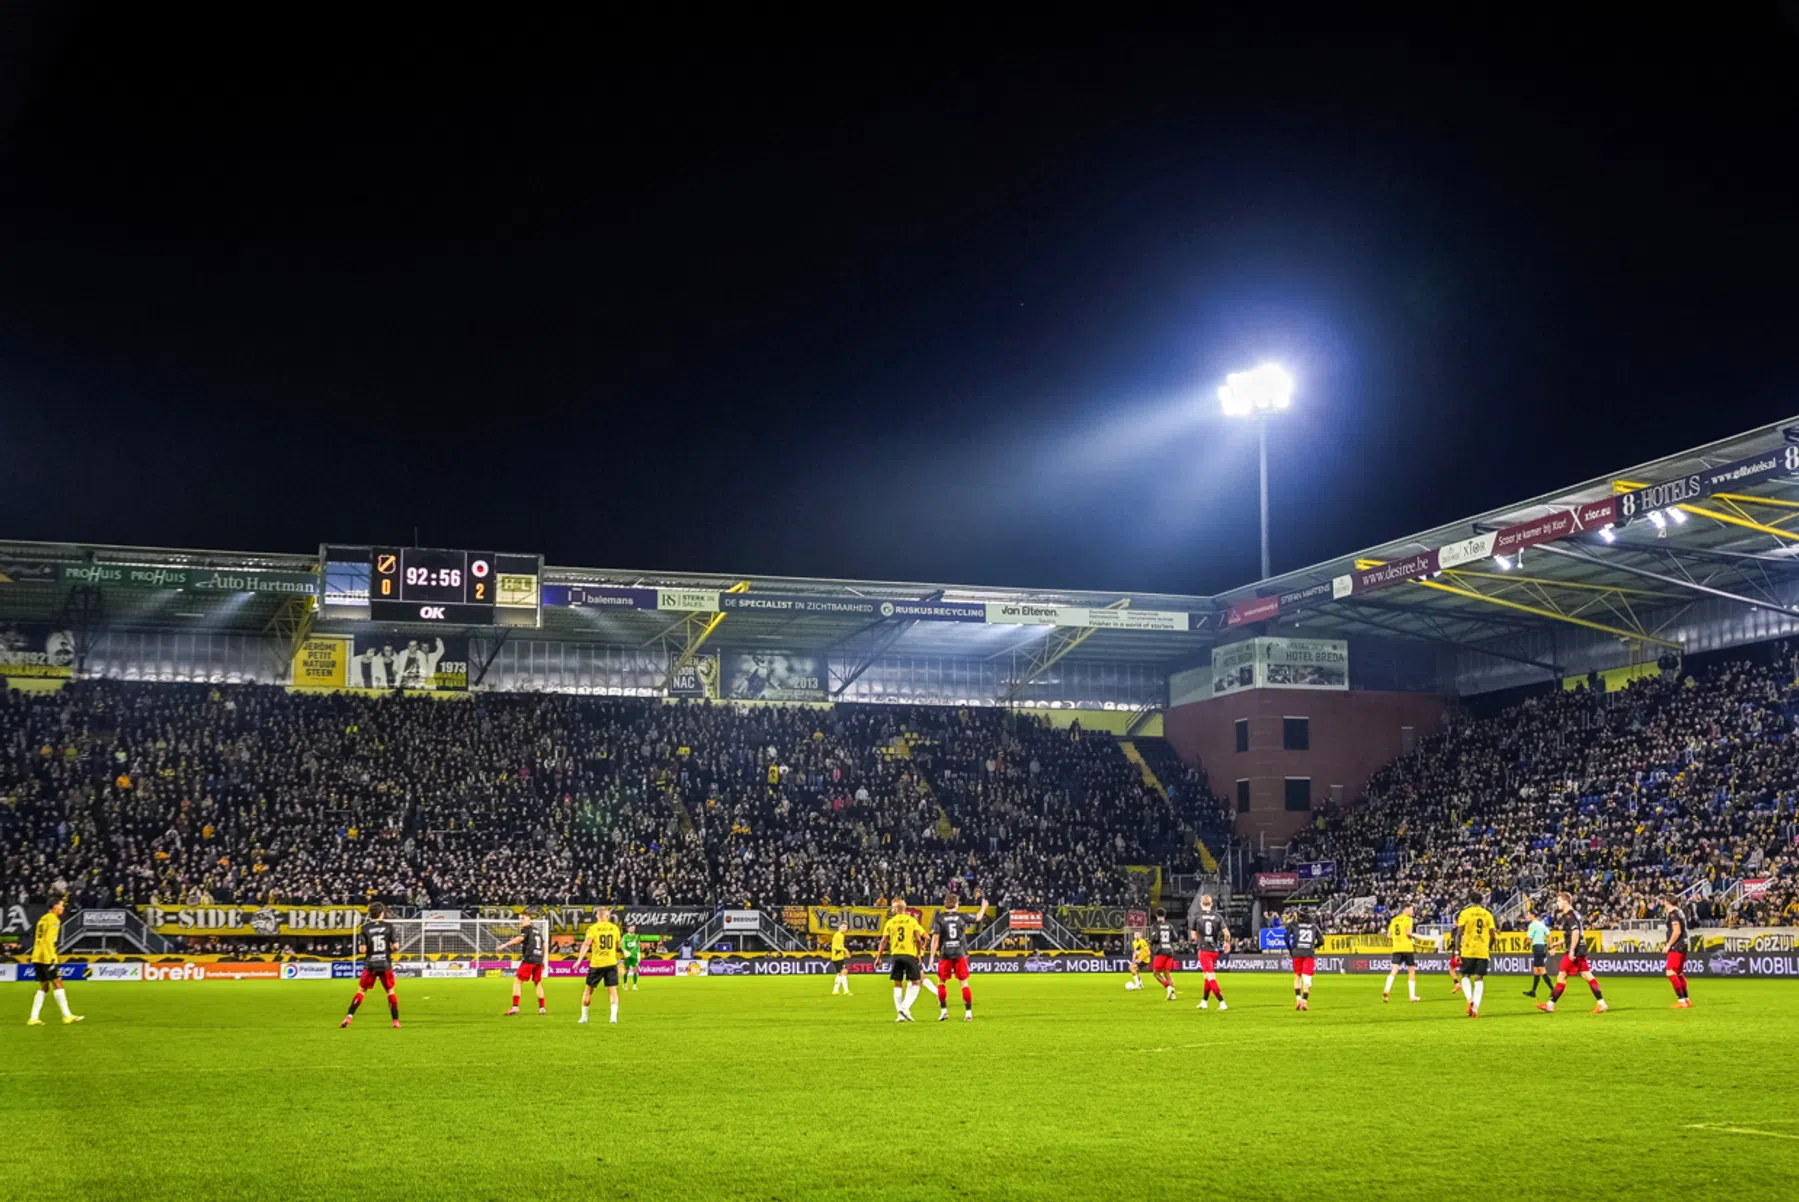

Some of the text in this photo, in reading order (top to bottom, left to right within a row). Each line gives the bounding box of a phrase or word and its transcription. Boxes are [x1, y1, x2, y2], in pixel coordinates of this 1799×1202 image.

[1640, 475, 1701, 511] HOTELS
[1584, 506, 1612, 522] xior.eu
[406, 566, 461, 587] 92:56
[1361, 556, 1429, 586] www.desiree.be
[195, 572, 315, 593] Auto Hartman
[381, 579, 392, 596] 0
[475, 583, 485, 600] 2
[420, 606, 446, 619] OK
[725, 599, 873, 613] DE SPECIALIST IN ZICHTBAARHEID
[895, 606, 984, 617] RUSKUS RECYCLING
[1286, 651, 1345, 662] HOTEL BREDA
[305, 668, 333, 677] STEEN
[440, 661, 467, 673] 1973
[673, 676, 695, 689] NAC
[794, 677, 819, 689] 2013
[146, 906, 244, 929] B-SIDE
[624, 911, 668, 926] ASOCIALE
[813, 908, 881, 931] Yellow
[1068, 909, 1126, 930] NAC
[898, 925, 905, 942] 3
[948, 923, 957, 939] 5
[1476, 919, 1484, 935] 9
[372, 935, 386, 952] 15
[599, 935, 613, 949] 90
[1299, 930, 1313, 943] 23
[1724, 937, 1751, 953] NIET
[143, 963, 205, 981] brefu
[754, 962, 831, 974] MOBILITY
[994, 962, 1019, 973] 2026
